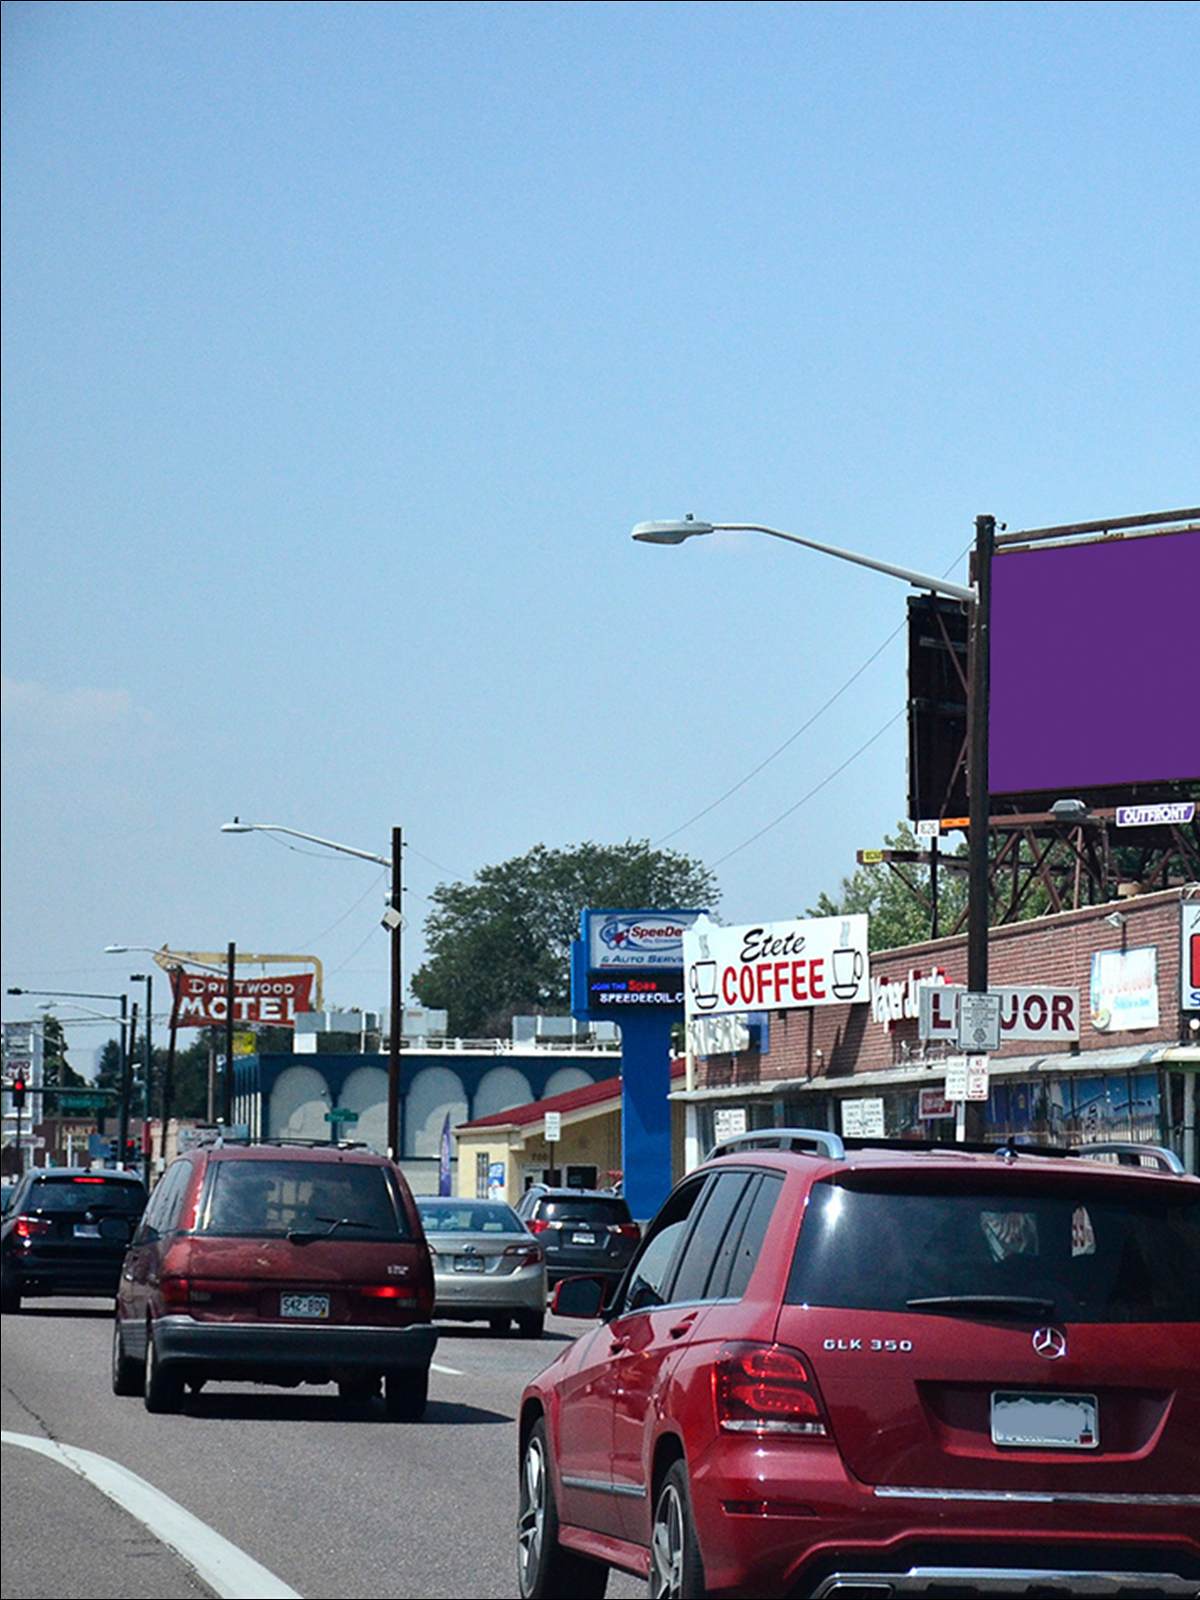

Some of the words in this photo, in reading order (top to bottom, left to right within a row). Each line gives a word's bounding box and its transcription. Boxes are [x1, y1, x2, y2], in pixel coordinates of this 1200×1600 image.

[1123, 805, 1188, 823] OUTFRONT
[631, 926, 684, 939] SpeeDe
[740, 928, 806, 963] Etete
[612, 955, 645, 963] AUTO
[648, 955, 684, 964] SERVI
[189, 978, 295, 994] DRITWOOD
[722, 958, 826, 1006] COFFEE
[599, 992, 685, 1004] SPEEDEEOIL.C
[180, 996, 296, 1021] MOTEL
[931, 992, 1076, 1031] LUOR
[823, 1339, 862, 1351] GLK
[870, 1339, 913, 1352] 350
